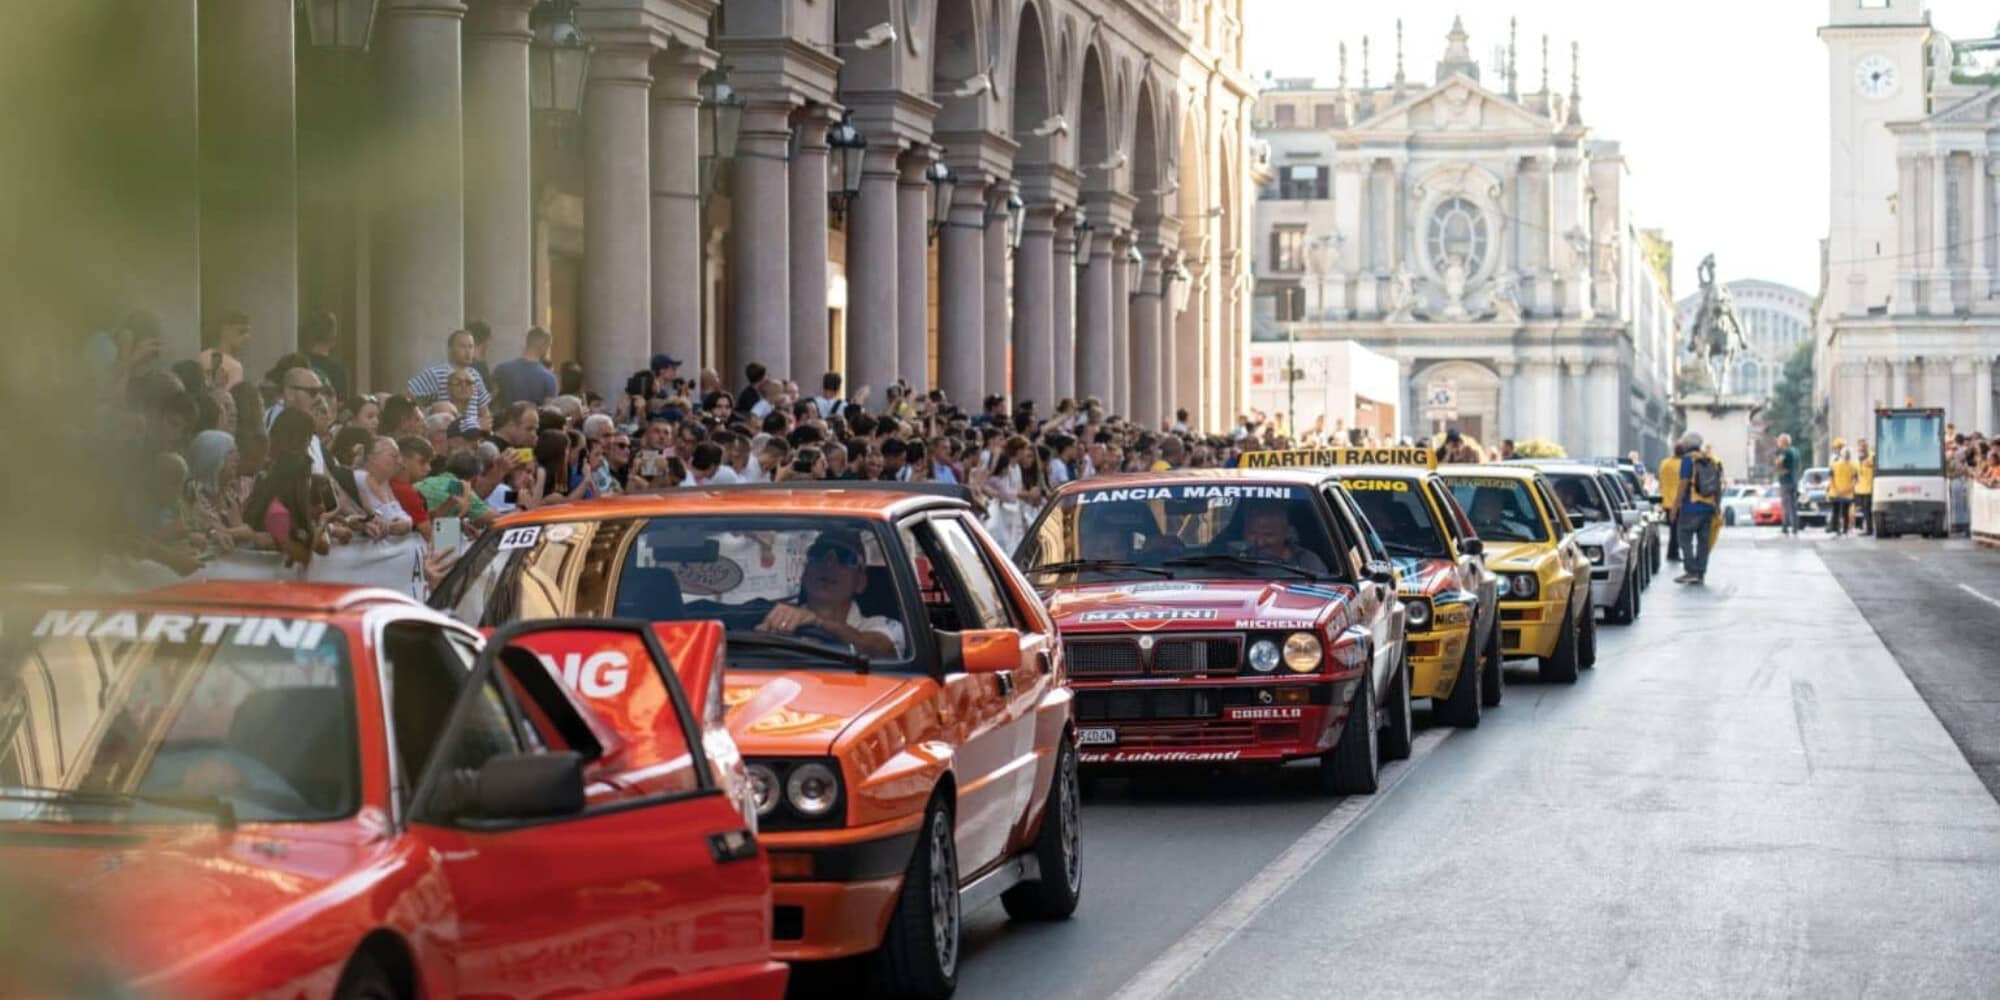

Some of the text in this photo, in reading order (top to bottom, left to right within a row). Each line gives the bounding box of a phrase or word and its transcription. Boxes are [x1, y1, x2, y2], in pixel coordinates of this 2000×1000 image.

[1250, 450, 1427, 468] MARTINI RACING
[1078, 485, 1291, 504] LANCIA MARTINI
[503, 529, 536, 548] 46
[1087, 608, 1216, 622] MARTINI
[32, 609, 328, 650] MARTINI
[1235, 620, 1314, 630] MICHELIN
[1079, 750, 1241, 763] iat Lubrificanti
